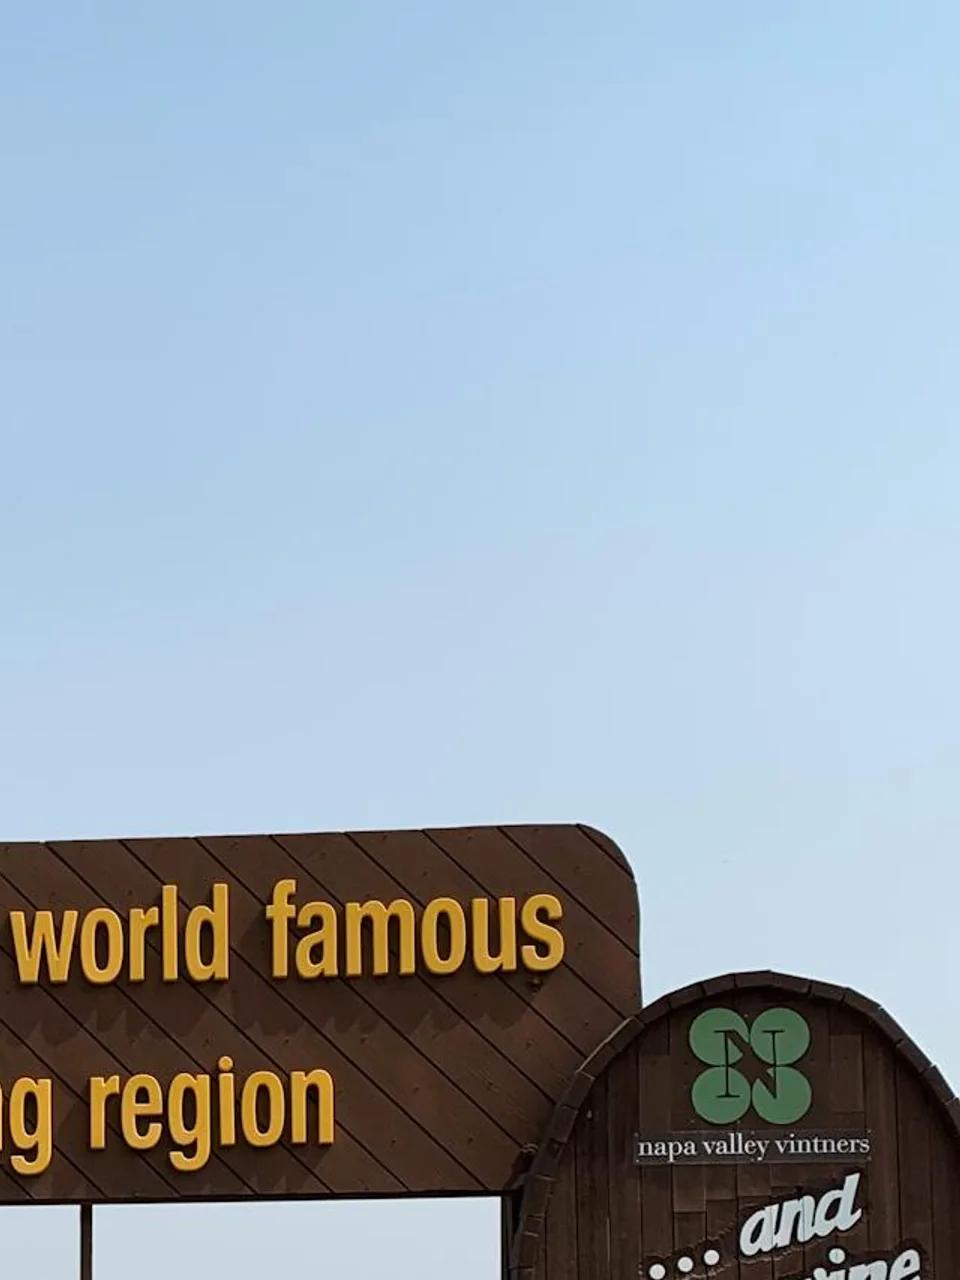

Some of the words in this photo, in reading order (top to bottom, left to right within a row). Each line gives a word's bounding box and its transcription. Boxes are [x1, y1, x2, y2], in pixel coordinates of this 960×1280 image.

[10, 883, 230, 985] world
[265, 879, 566, 975] famous
[89, 1056, 335, 1172] region
[638, 1140, 697, 1162] napa
[703, 1132, 770, 1161] valley
[775, 1133, 871, 1155] vintners
